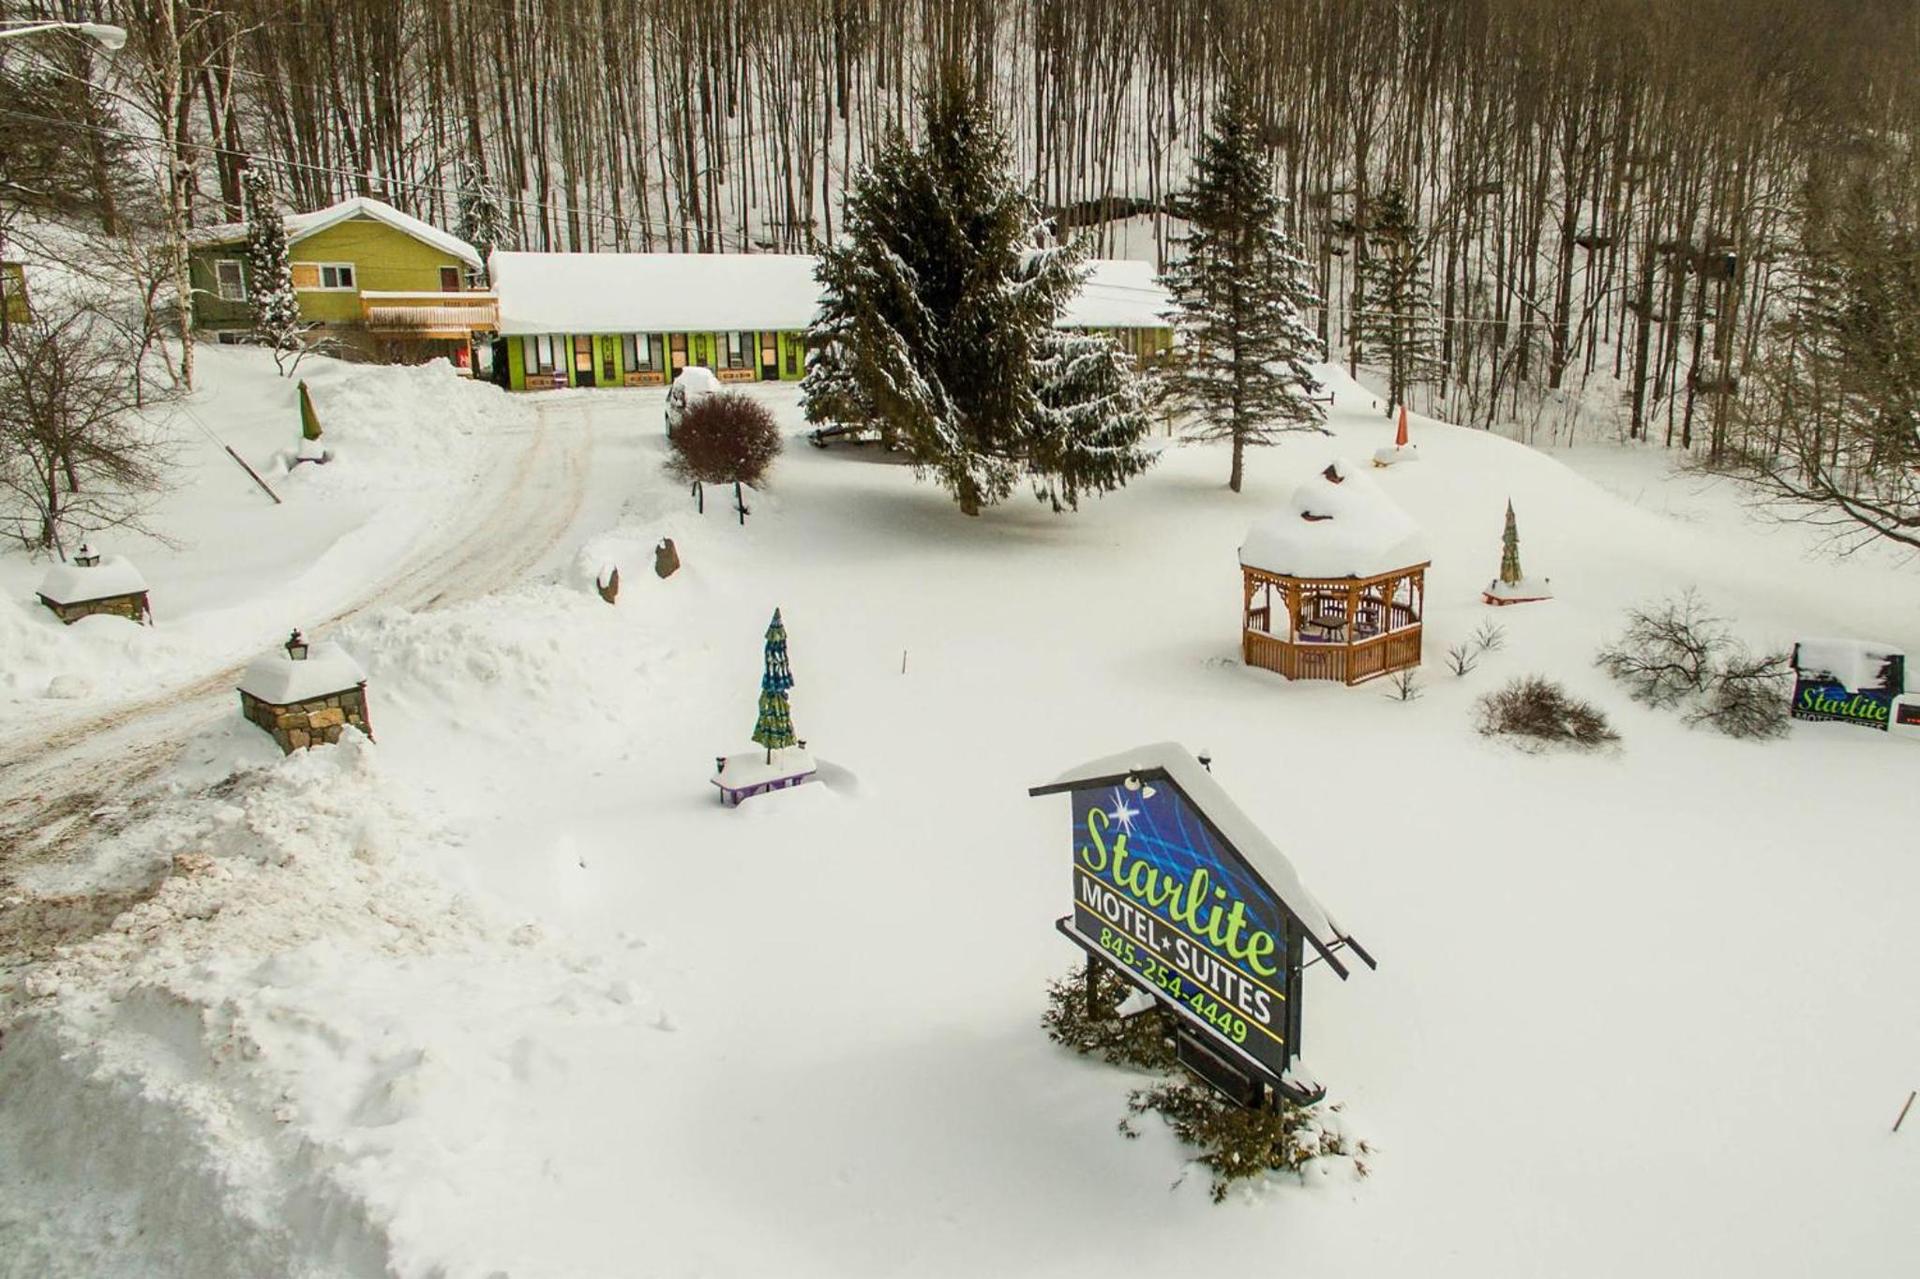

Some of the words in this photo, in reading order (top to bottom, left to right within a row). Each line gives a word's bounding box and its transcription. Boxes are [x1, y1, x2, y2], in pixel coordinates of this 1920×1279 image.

[1799, 688, 1888, 721] Starlite
[1082, 876, 1161, 952] MOTEL
[1175, 938, 1271, 1025] SUITES
[1083, 807, 1278, 977] Starlite
[1100, 927, 1248, 1044] 845-254-4449
